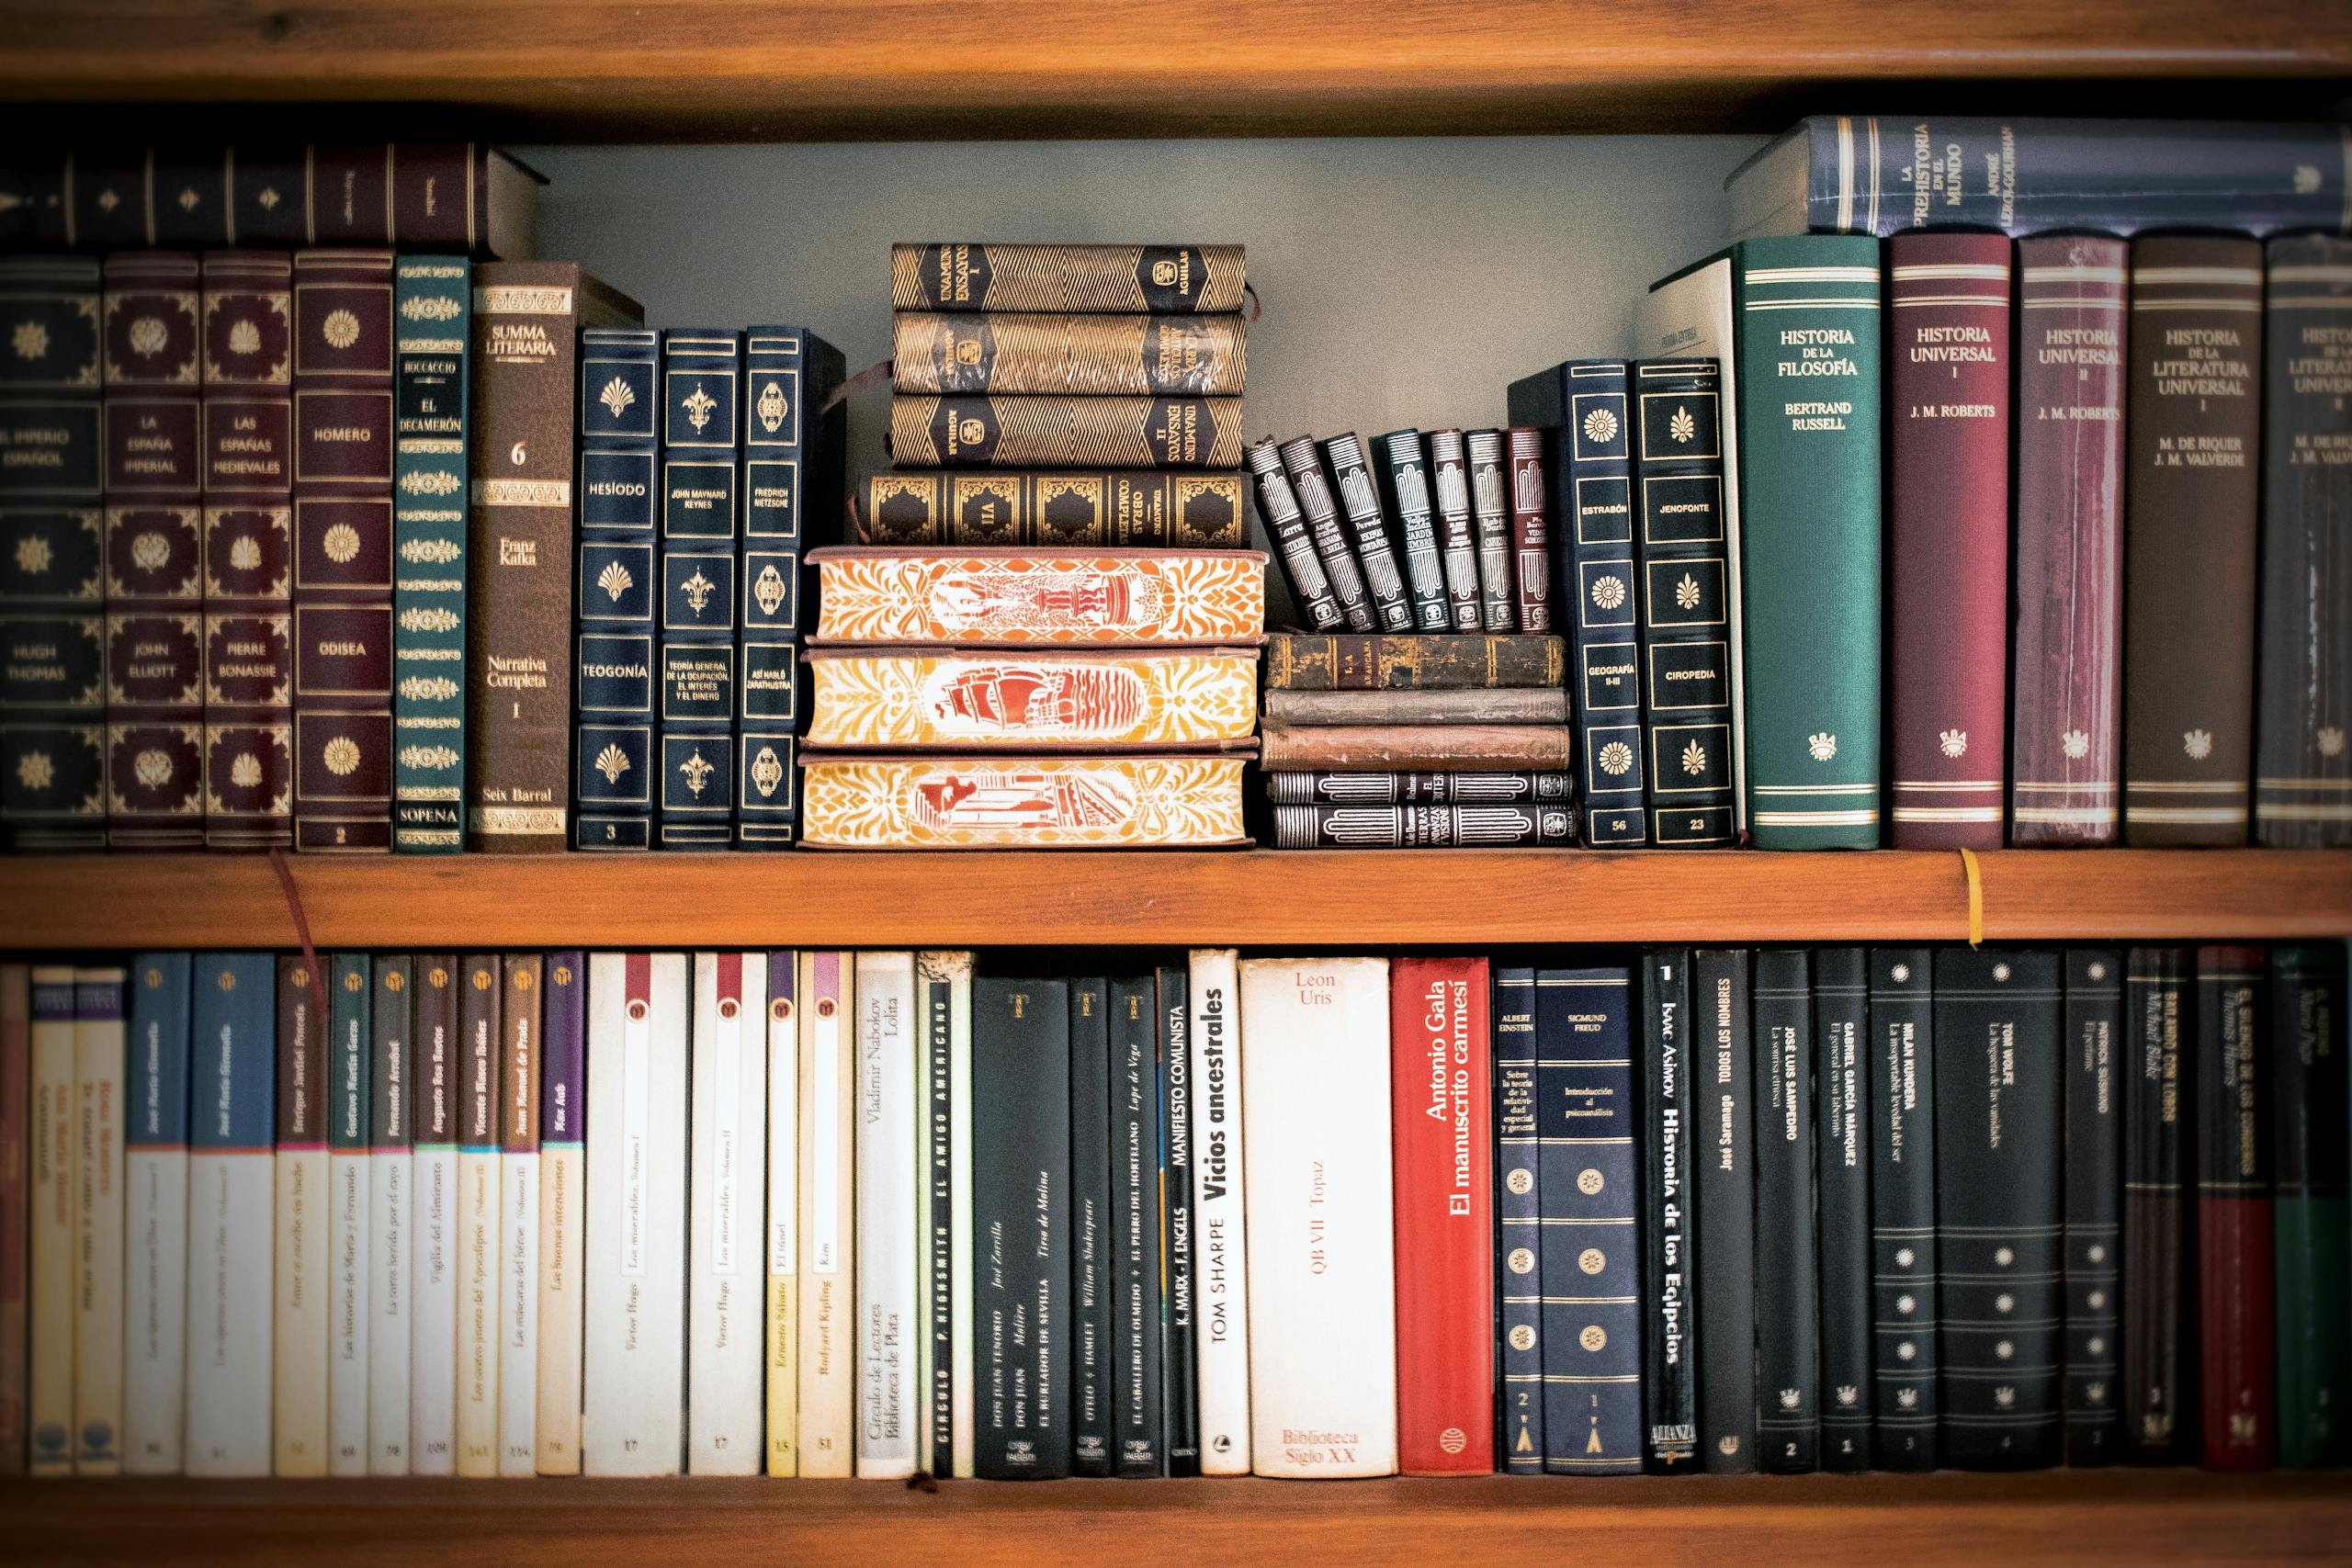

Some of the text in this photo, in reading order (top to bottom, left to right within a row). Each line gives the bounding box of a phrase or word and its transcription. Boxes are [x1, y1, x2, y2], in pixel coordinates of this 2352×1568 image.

[1902, 167, 1912, 181] LA
[1914, 125, 1930, 226] PREHISTORIA
[1933, 159, 1943, 190] EN EL
[1947, 143, 1962, 206] MUNDO
[941, 245, 952, 301] UNAMUNO
[956, 245, 969, 301] ENSAYOS
[1180, 253, 1190, 294] AGUILAR
[493, 325, 546, 341] SUMMA
[1781, 329, 1855, 344] HISTORIA
[1917, 327, 1991, 343] HISTORIA
[2166, 330, 2240, 345] HISTORIA
[487, 341, 556, 355] LITERARIA
[1803, 347, 1834, 358] DE LA
[1911, 347, 1996, 362] UNIVERSAL
[404, 362, 456, 373] BOCCACCIO
[1779, 358, 1859, 377] FILOSOFÍA
[1953, 367, 1957, 378] I
[2154, 360, 2249, 378] LITERATURA
[2159, 378, 2245, 396] UNIVERSAL
[422, 400, 435, 412] EL
[1785, 401, 1852, 415] BERTRAND
[1910, 404, 1996, 419] J. M. ROBERTS
[234, 417, 256, 430] LAS
[401, 416, 460, 432] DECAMERÓN
[1792, 417, 1846, 430] RUSSELL
[314, 428, 370, 442] HOMERO
[947, 411, 957, 454] AGUILAR
[1157, 429, 1166, 440] II
[1167, 406, 1182, 460] ENSAYOS
[1184, 407, 1196, 460] UNAMUNO
[220, 438, 271, 452] ESPAÑAS
[511, 442, 526, 465] 6
[2154, 451, 2245, 468] J. M. VALVERDE
[214, 460, 280, 474] MEDIEVALES
[589, 481, 644, 496] HESÍODO
[672, 489, 727, 500] JOHN MAYNARD
[754, 488, 788, 497] FRIEDRICH
[684, 500, 712, 508] KEYNES
[754, 498, 788, 507] NIETZSCHE
[1583, 503, 1627, 515] ESTRABÓN
[1660, 504, 1709, 513] JENOFONTE
[982, 504, 994, 527] VII
[1117, 479, 1130, 546] COMPLETAS
[1132, 493, 1145, 534] OBRAS
[500, 537, 536, 554] Franz
[501, 551, 537, 565] Kafka
[227, 643, 265, 655] PIERRE
[319, 642, 366, 656] ODISEA
[219, 665, 276, 677] BONASSIE
[489, 656, 547, 671] Narrativa
[583, 663, 648, 678] TEOGONÍA
[670, 660, 727, 671] TEORÍA GENERAL
[1589, 664, 1634, 675] GEOGRAFÍA
[487, 671, 547, 690] Completa
[666, 671, 675, 680] DE
[753, 670, 786, 681] ASÍ HABLÓ
[1606, 677, 1620, 685] II-III
[1666, 670, 1715, 681] CIROPEDIA
[677, 682, 717, 691] EL INTERÉS
[747, 680, 790, 690] ZARATHUSTRA
[683, 691, 690, 700] EL
[482, 788, 553, 801] Seix Barral
[401, 808, 458, 822] SOPENA
[1418, 807, 1430, 844] TIERRAS
[1612, 820, 1626, 830] 56
[1690, 819, 1704, 829] 23
[336, 828, 345, 843] 2
[607, 827, 616, 840] 3
[1295, 973, 1336, 989] Leon
[1661, 964, 1672, 983] 1
[1300, 990, 1333, 1006] Uris
[883, 997, 900, 1037] Lolita
[1425, 980, 1447, 1122] Antonio Gala
[2002, 1022, 2014, 1086] TOM WOLFE
[867, 997, 880, 1123] Vladimir Nabokov
[1903, 1022, 1916, 1111] MILAN KUNDERA
[514, 1016, 532, 1137] Juan Manuel de Prada
[1717, 977, 1735, 1170] José Saramago TODOS LOS NOMBRES
[1785, 1027, 1797, 1141] JOSÉ LUIS SAMPEDRO
[1449, 980, 1470, 1216] El manuscrito carmesí
[1843, 1021, 1858, 1167] GABRIEL GARCÍA MÁRQUEZ
[555, 1081, 565, 1132] Max Aub
[935, 1001, 947, 1341] P. HIGHSMITH EL AMIGO AMERICANO
[1170, 1006, 1189, 1325] K. MARX F. ENGELS MANIFIESTO COMUNISTA
[1201, 987, 1226, 1344] TOM SHARPE Vicios ancestrales
[1308, 1158, 1328, 1276] QB VII Topaz
[1665, 1203, 1680, 1226] de
[1083, 1197, 1096, 1260] Shakespeare
[1666, 1235, 1680, 1266] los
[1083, 1265, 1093, 1308] William
[819, 1242, 832, 1376] Rudyard Kipling Kim
[990, 1221, 1003, 1427] DON JUAN TENORIO José Zorrilla
[1083, 1321, 1095, 1366] HAMLET
[1084, 1385, 1097, 1421] OTELO
[1519, 1393, 1528, 1405] 2
[1283, 1428, 1358, 1446] Biblioteca
[1285, 1449, 1355, 1464] Siglo XX
[1785, 1442, 1797, 1456] 2
